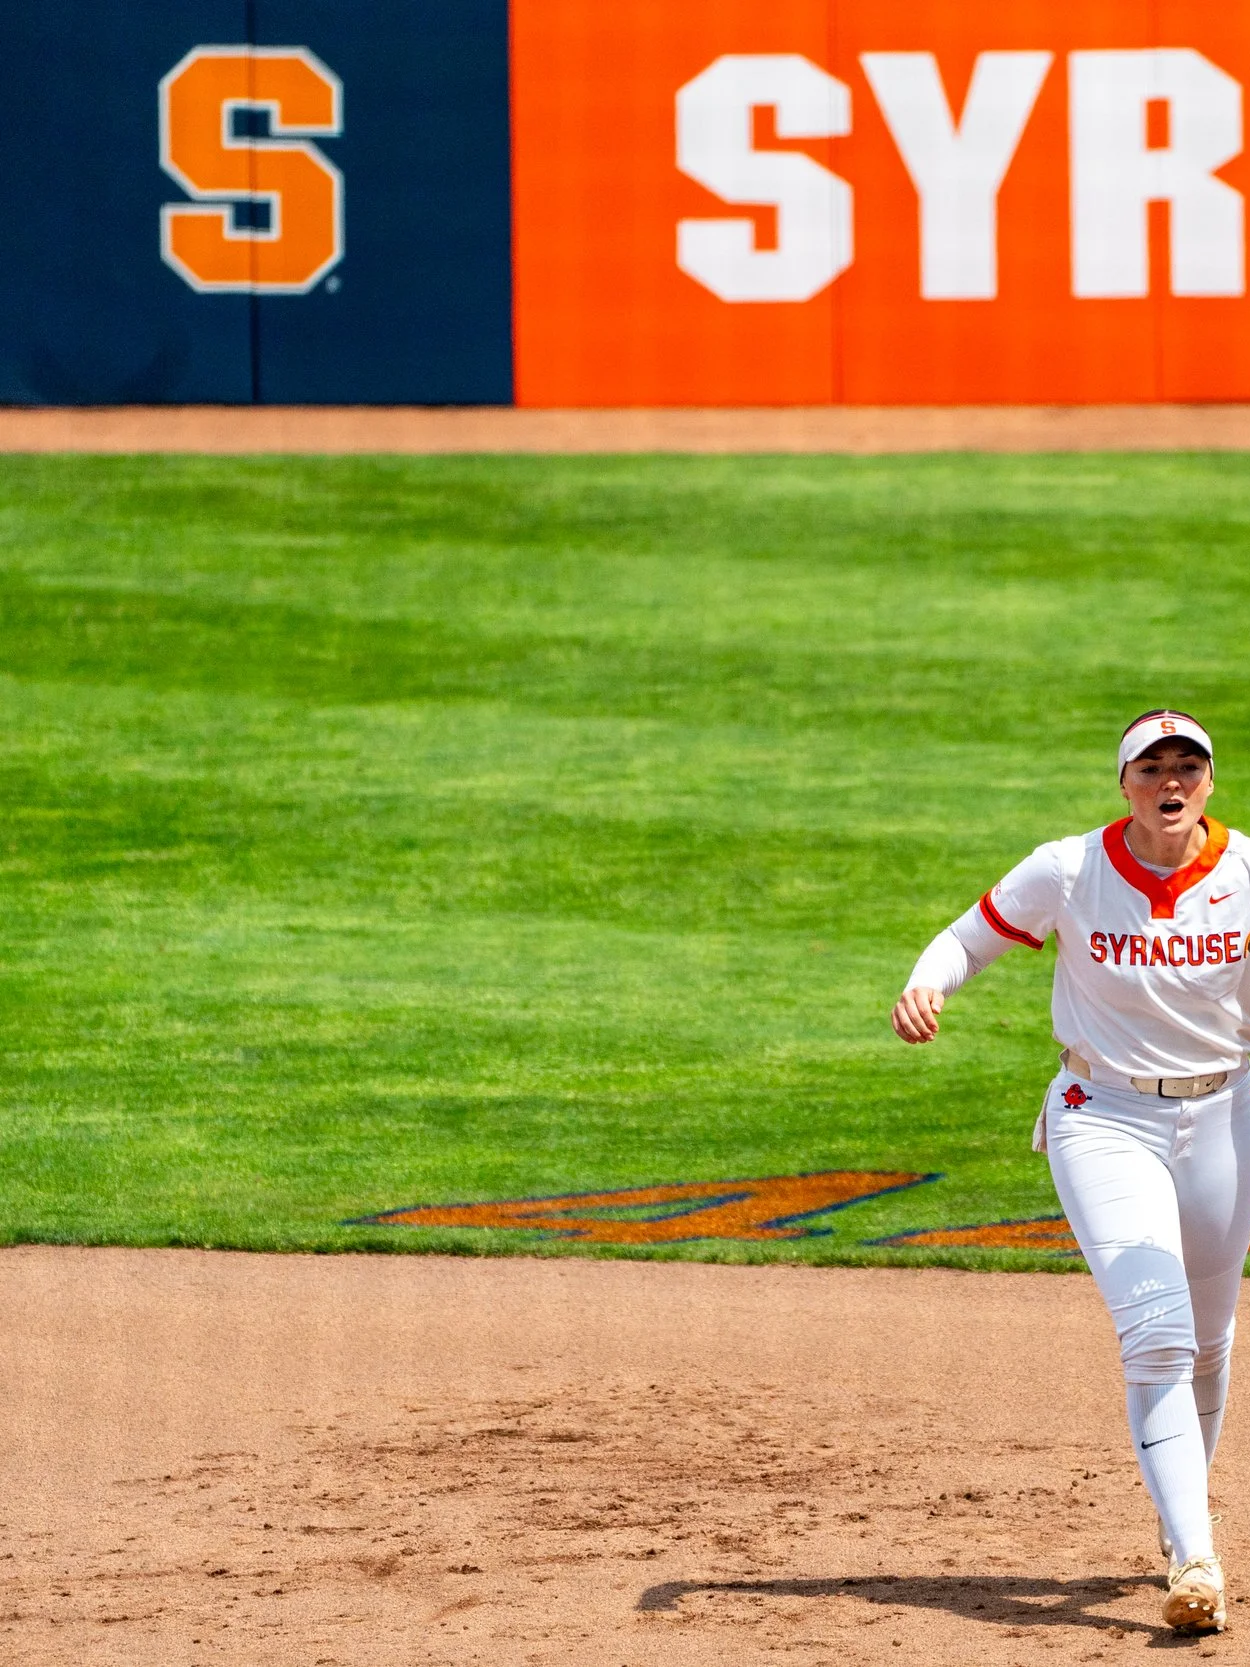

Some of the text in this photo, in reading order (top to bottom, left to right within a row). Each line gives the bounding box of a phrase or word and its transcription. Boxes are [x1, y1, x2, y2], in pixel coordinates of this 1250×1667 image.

[158, 45, 344, 294] S
[1160, 720, 1177, 735] S
[1090, 931, 1242, 967] SYRACUSE
